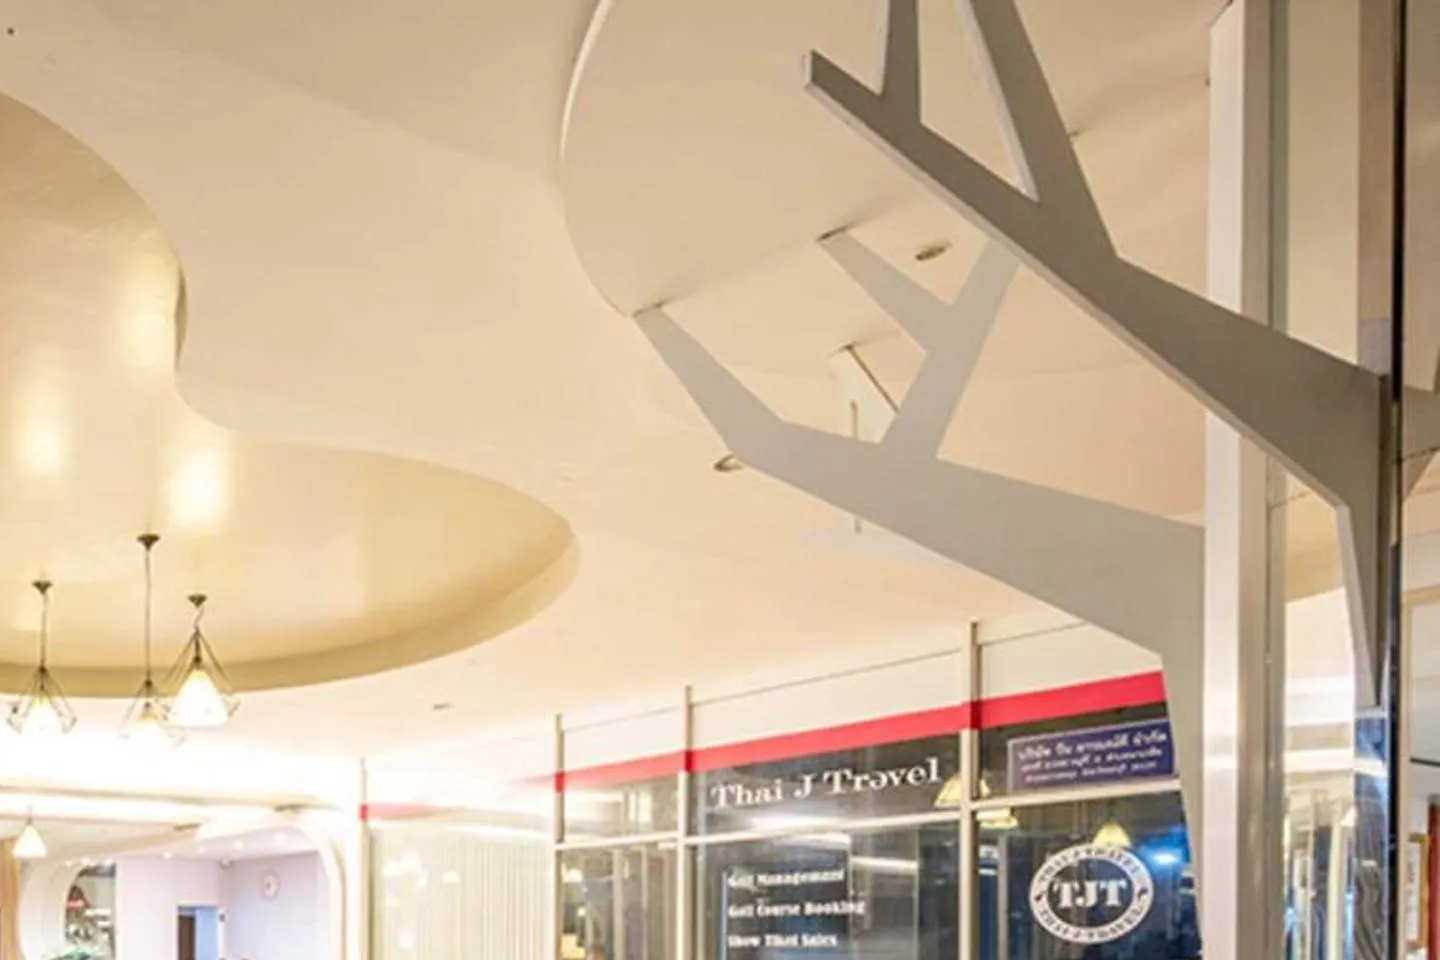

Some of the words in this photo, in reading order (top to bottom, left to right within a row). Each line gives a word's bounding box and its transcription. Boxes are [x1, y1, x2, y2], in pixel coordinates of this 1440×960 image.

[711, 778, 783, 808] Thai
[793, 773, 818, 799] J
[757, 869, 845, 886] Management
[1052, 880, 1128, 908] TJT
[757, 904, 801, 917] Course
[804, 901, 865, 916] Booking
